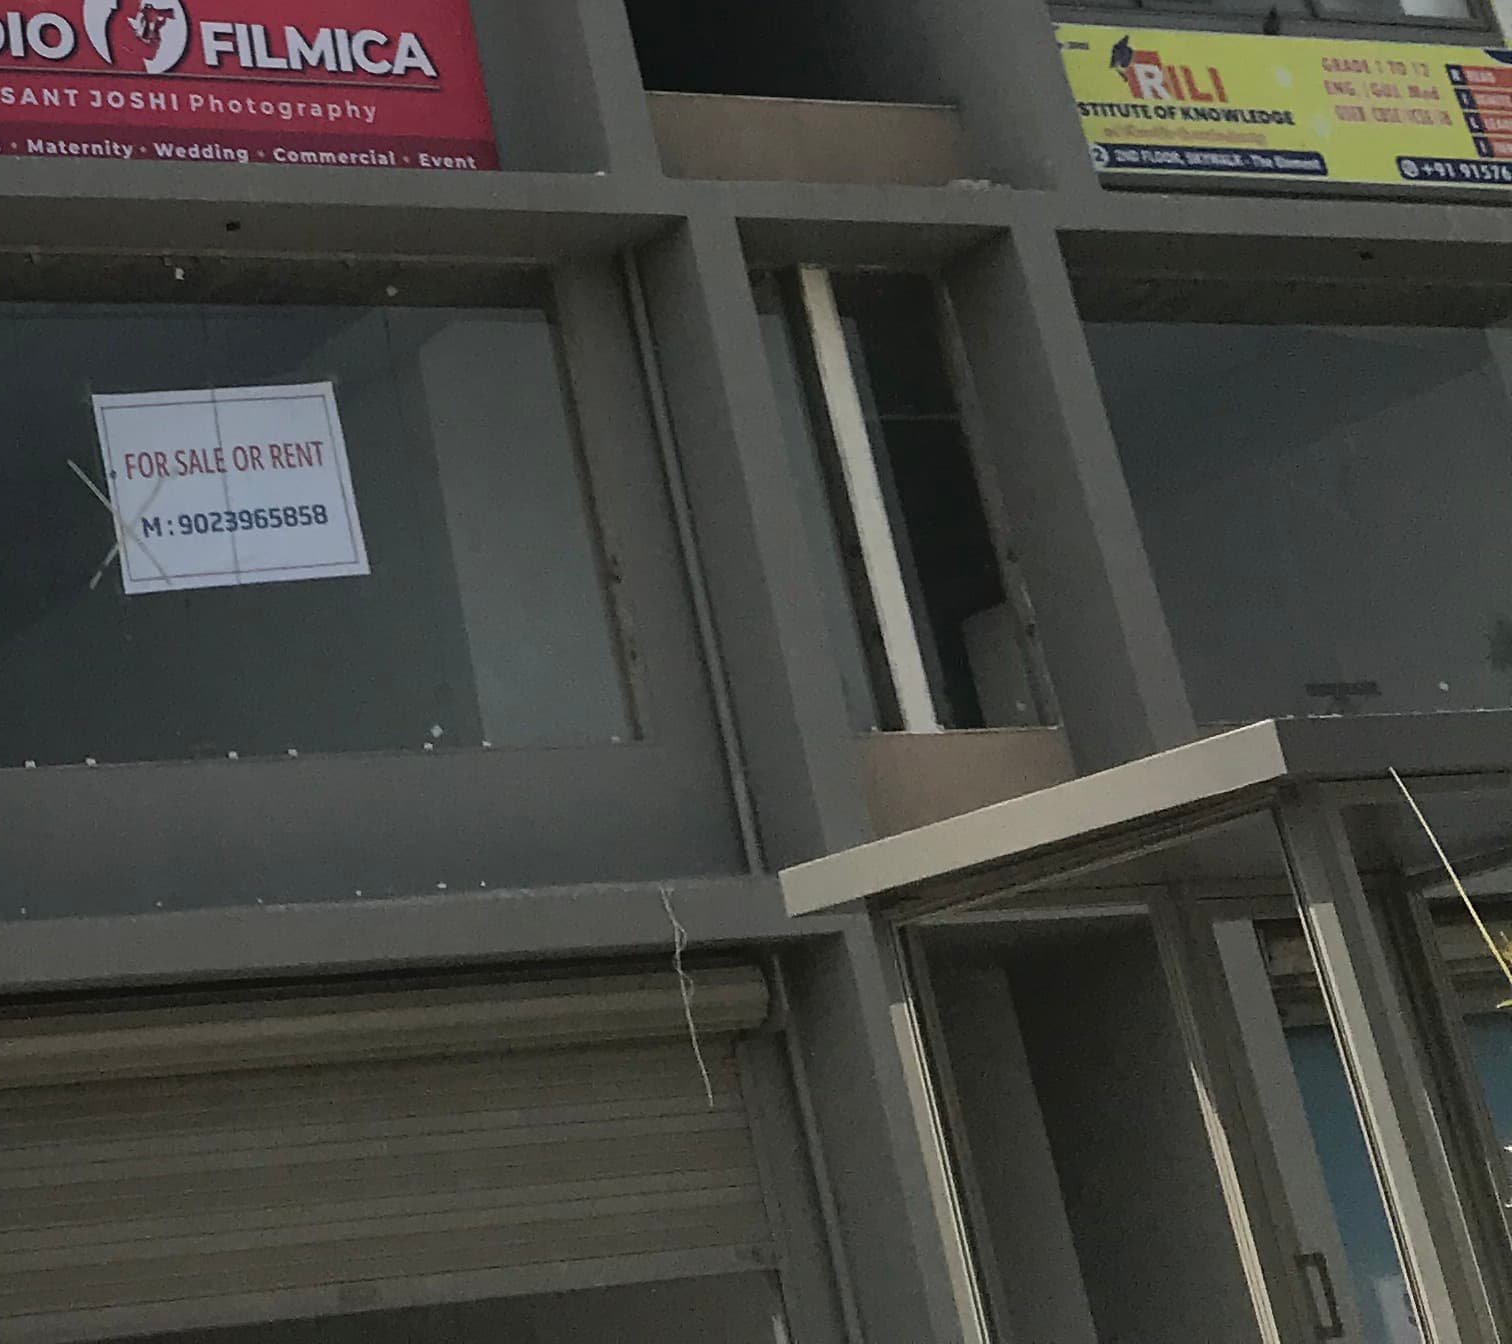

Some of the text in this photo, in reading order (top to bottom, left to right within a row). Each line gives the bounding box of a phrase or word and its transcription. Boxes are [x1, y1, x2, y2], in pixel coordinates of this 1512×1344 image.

[199, 21, 438, 78] FILMICA
[1129, 60, 1229, 103] RILI
[90, 88, 179, 111] JOSHI
[190, 93, 376, 123] Photography
[1077, 101, 1296, 125] STITUTE OF KNOWLEDGE
[27, 138, 134, 160] Maternity
[153, 142, 249, 163] Wedding
[273, 147, 396, 165] Commercial
[418, 153, 476, 169] Event
[125, 440, 323, 480] FOR SALE OR RENT
